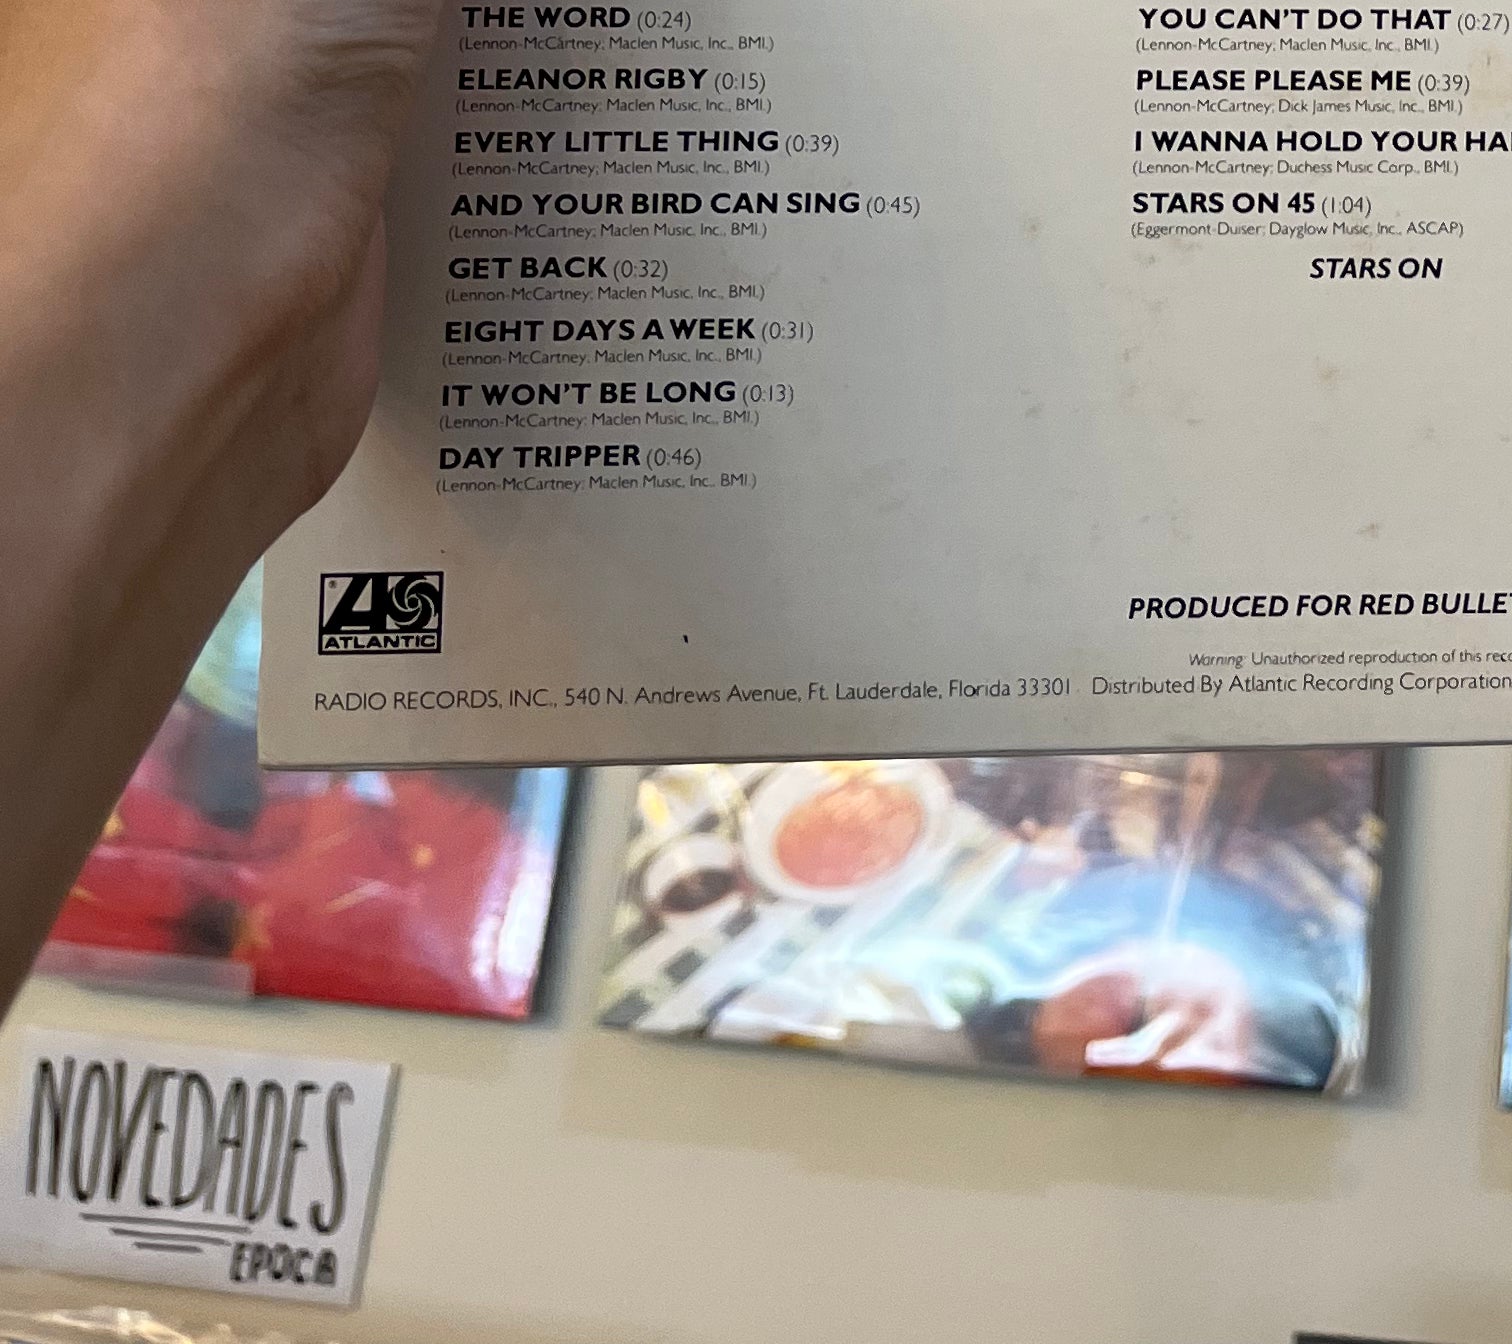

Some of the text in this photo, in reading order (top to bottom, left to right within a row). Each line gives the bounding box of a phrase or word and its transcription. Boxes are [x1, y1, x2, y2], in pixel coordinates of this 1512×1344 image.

[458, 67, 765, 95] ELEANOR RIGBY (0:15)
[1137, 69, 1469, 96] PLEASE PLEASE ME (0:39)
[1310, 256, 1443, 280] STARS ON
[440, 444, 701, 472] DAY TRIPPER (0:46)
[1129, 595, 1288, 620] PRODUCED
[1296, 594, 1351, 617] FOR
[1359, 593, 1414, 616] RED
[324, 633, 437, 650] ATLANTIC
[1251, 651, 1345, 666] Unauthorized
[1348, 650, 1439, 665] reproduction
[1441, 649, 1458, 663] of
[1459, 648, 1482, 662] this
[315, 691, 386, 712] RADIO
[394, 689, 502, 711] RECORDS,
[564, 686, 600, 707] 540
[634, 685, 720, 705] Andrews
[726, 683, 801, 703] Avenue,
[836, 681, 942, 701] Lauderdale,
[949, 679, 1010, 698] Florida
[1018, 677, 1069, 697] 33301
[26, 1057, 354, 1236] NOVEDADES
[230, 1242, 338, 1284] EPOCA
